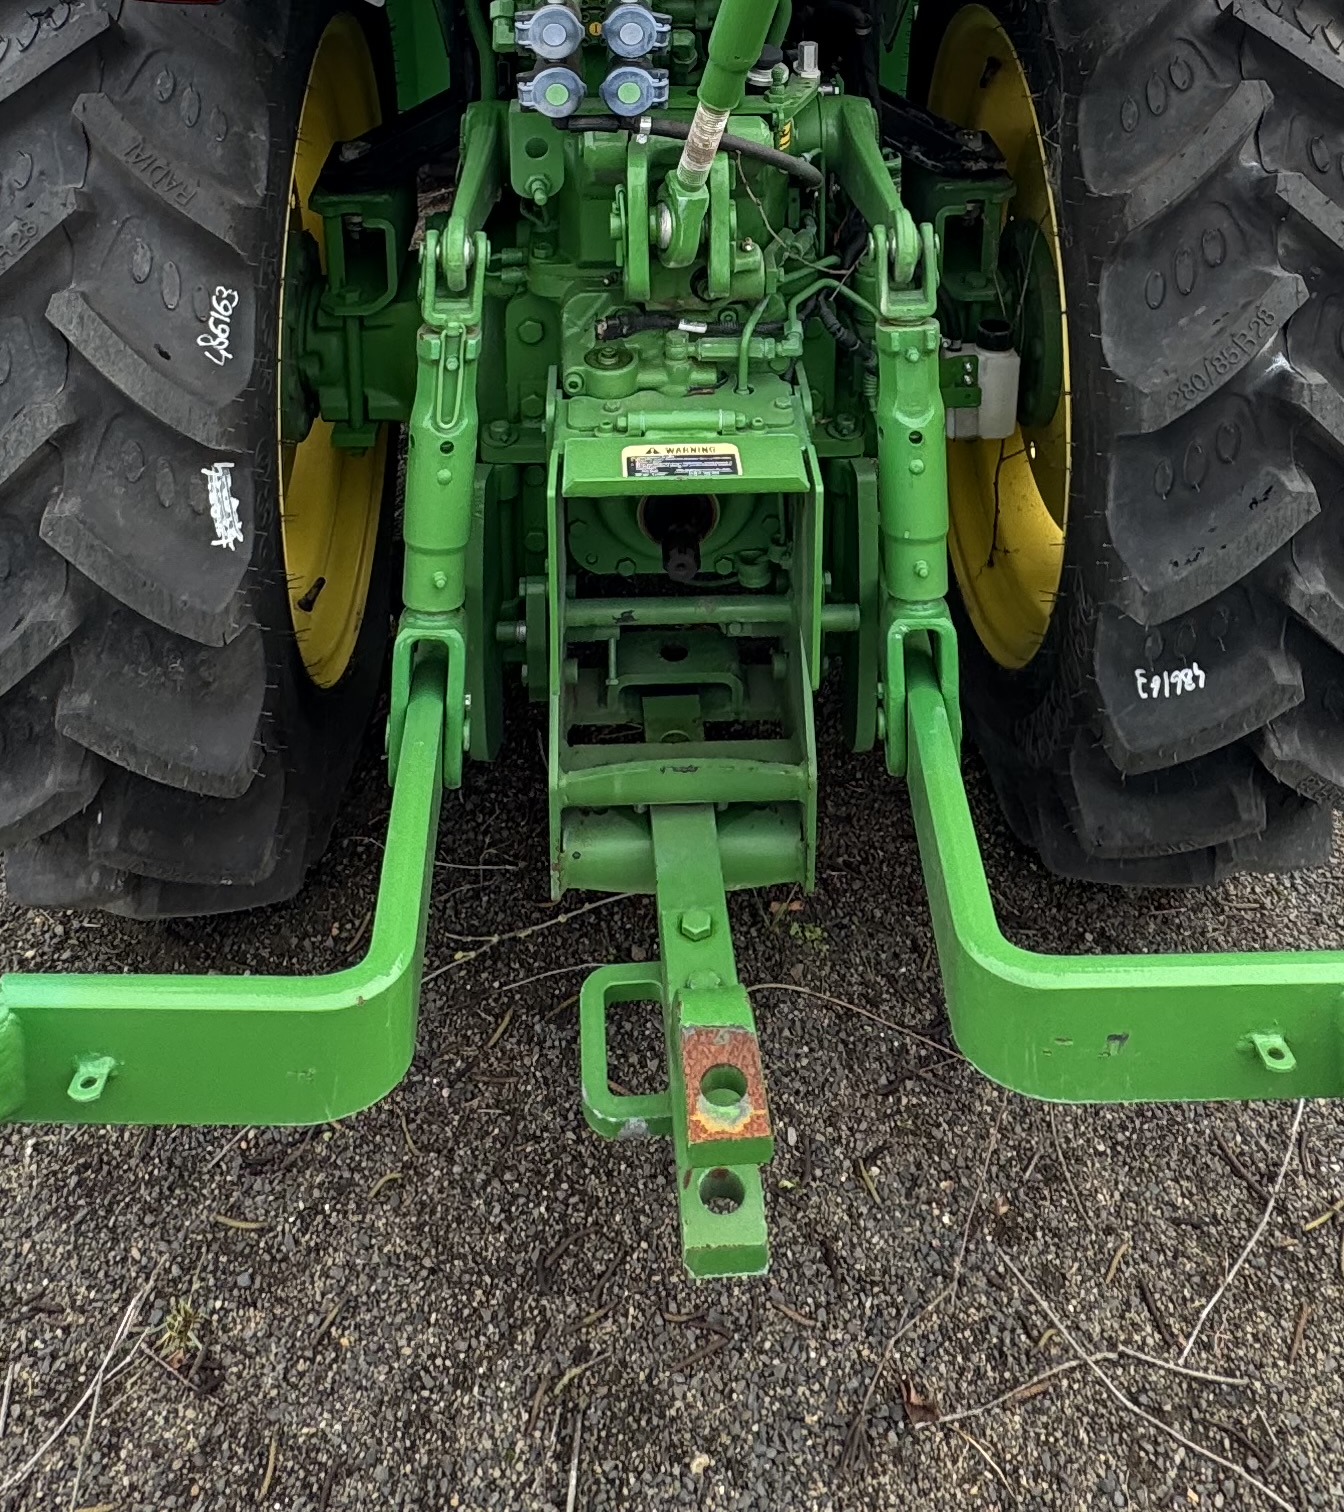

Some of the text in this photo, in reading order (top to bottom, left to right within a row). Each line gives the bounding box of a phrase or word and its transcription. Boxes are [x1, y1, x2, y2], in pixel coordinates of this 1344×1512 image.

[196, 285, 239, 366] 486163
[665, 446, 716, 454] WARNING
[1134, 661, 1206, 699] 486163
